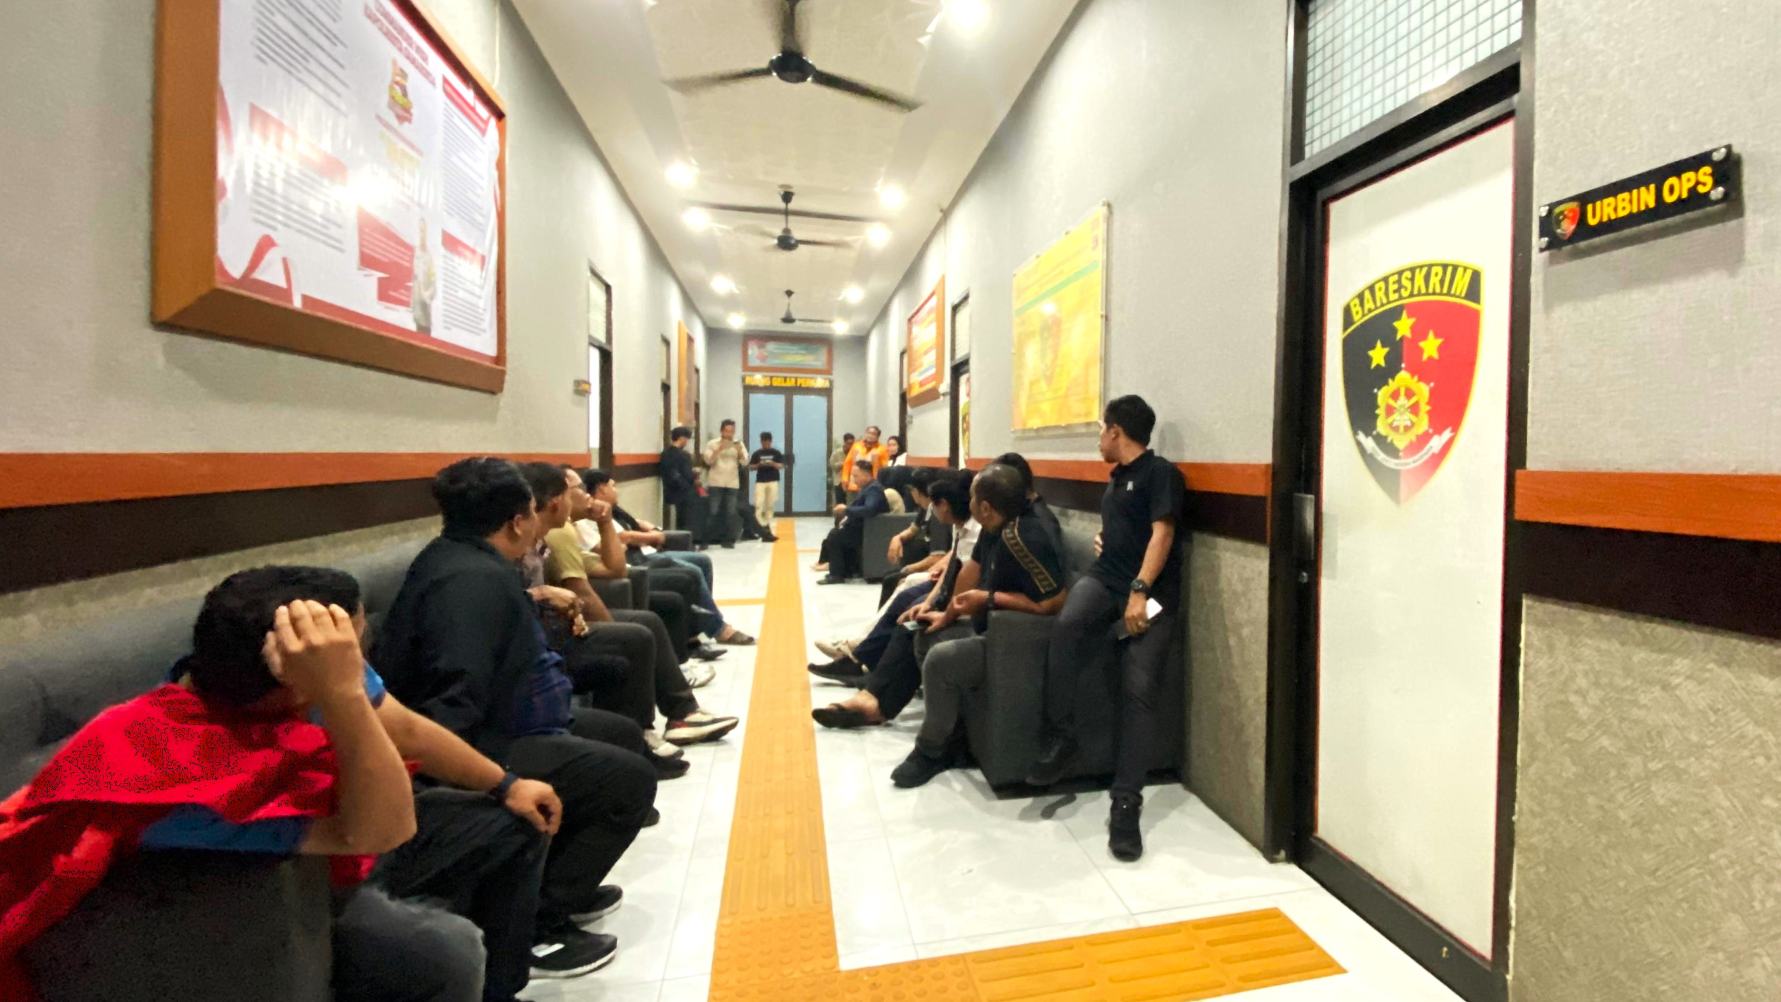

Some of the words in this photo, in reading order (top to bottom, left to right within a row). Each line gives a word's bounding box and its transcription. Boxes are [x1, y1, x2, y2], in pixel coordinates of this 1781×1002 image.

[1586, 184, 1656, 225] URBIN
[1662, 166, 1713, 203] OPS
[1350, 266, 1473, 322] BARESKRIM
[797, 377, 830, 388] PERA
